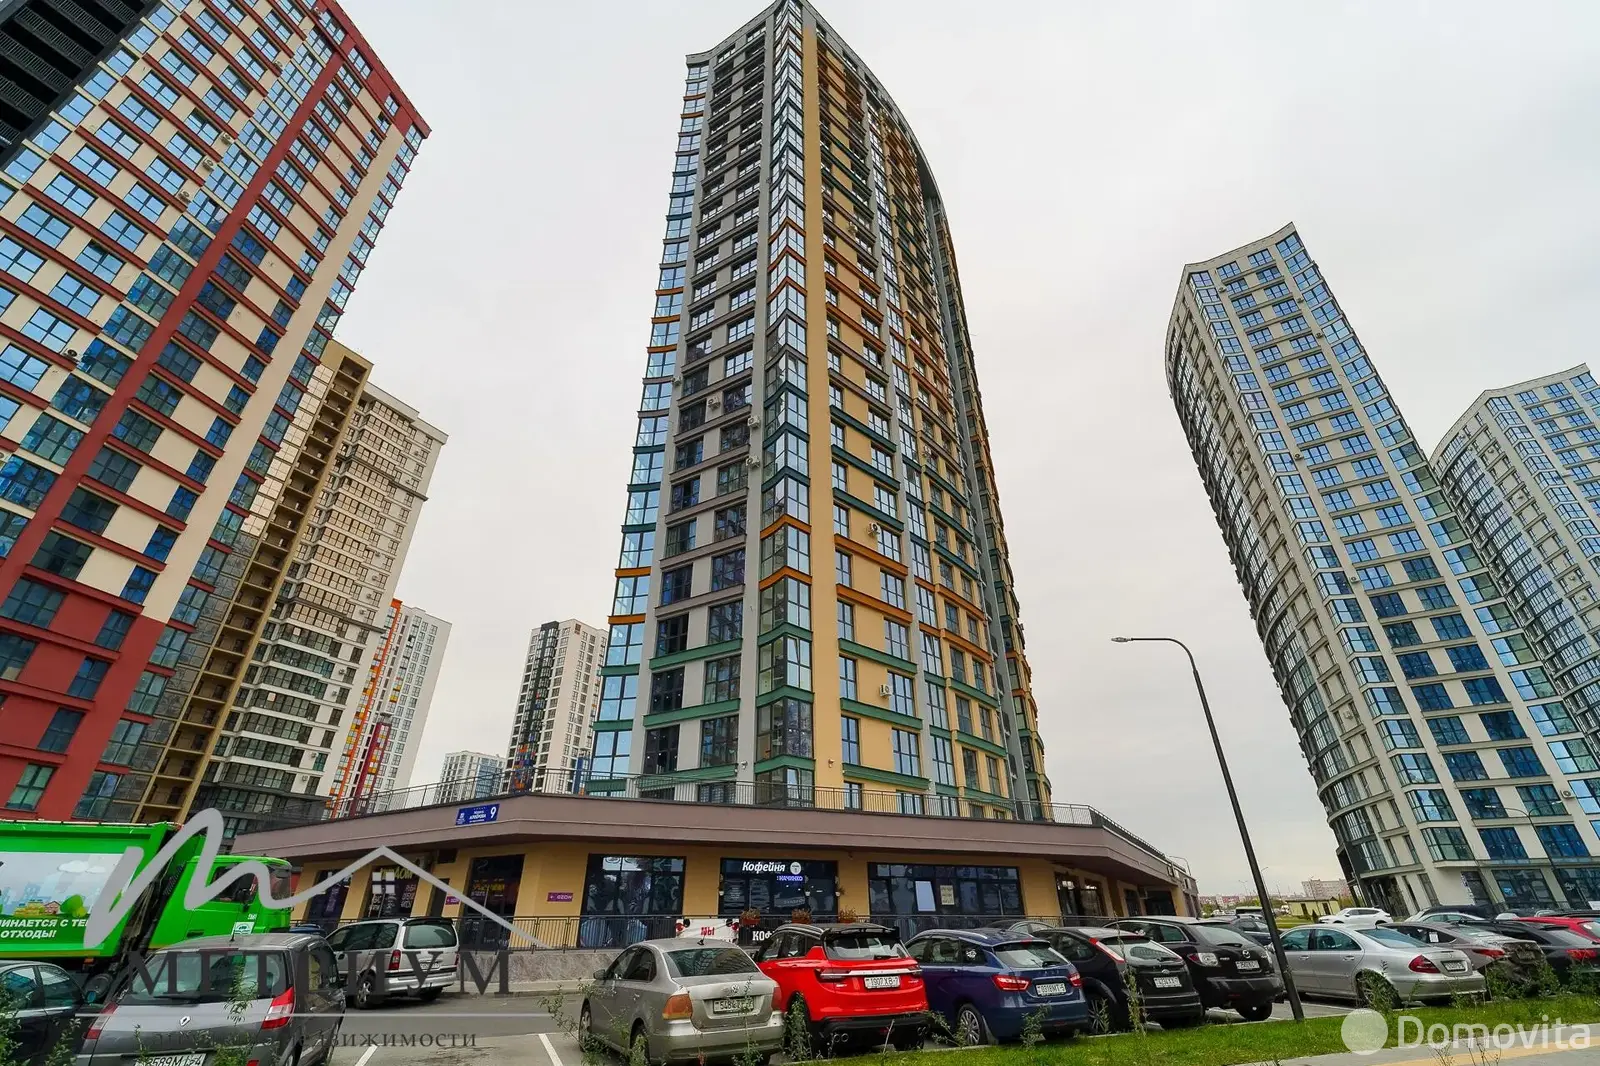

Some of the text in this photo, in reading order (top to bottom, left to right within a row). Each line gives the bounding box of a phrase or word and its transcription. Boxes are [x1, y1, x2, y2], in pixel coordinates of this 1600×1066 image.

[490, 806, 497, 819] 9
[742, 861, 786, 874] Кофейня
[0, 919, 58, 928] ИНАЕТСЯ
[60, 919, 68, 927] С
[0, 929, 58, 939] ОТХОДЫ!
[752, 930, 776, 941] КОФ
